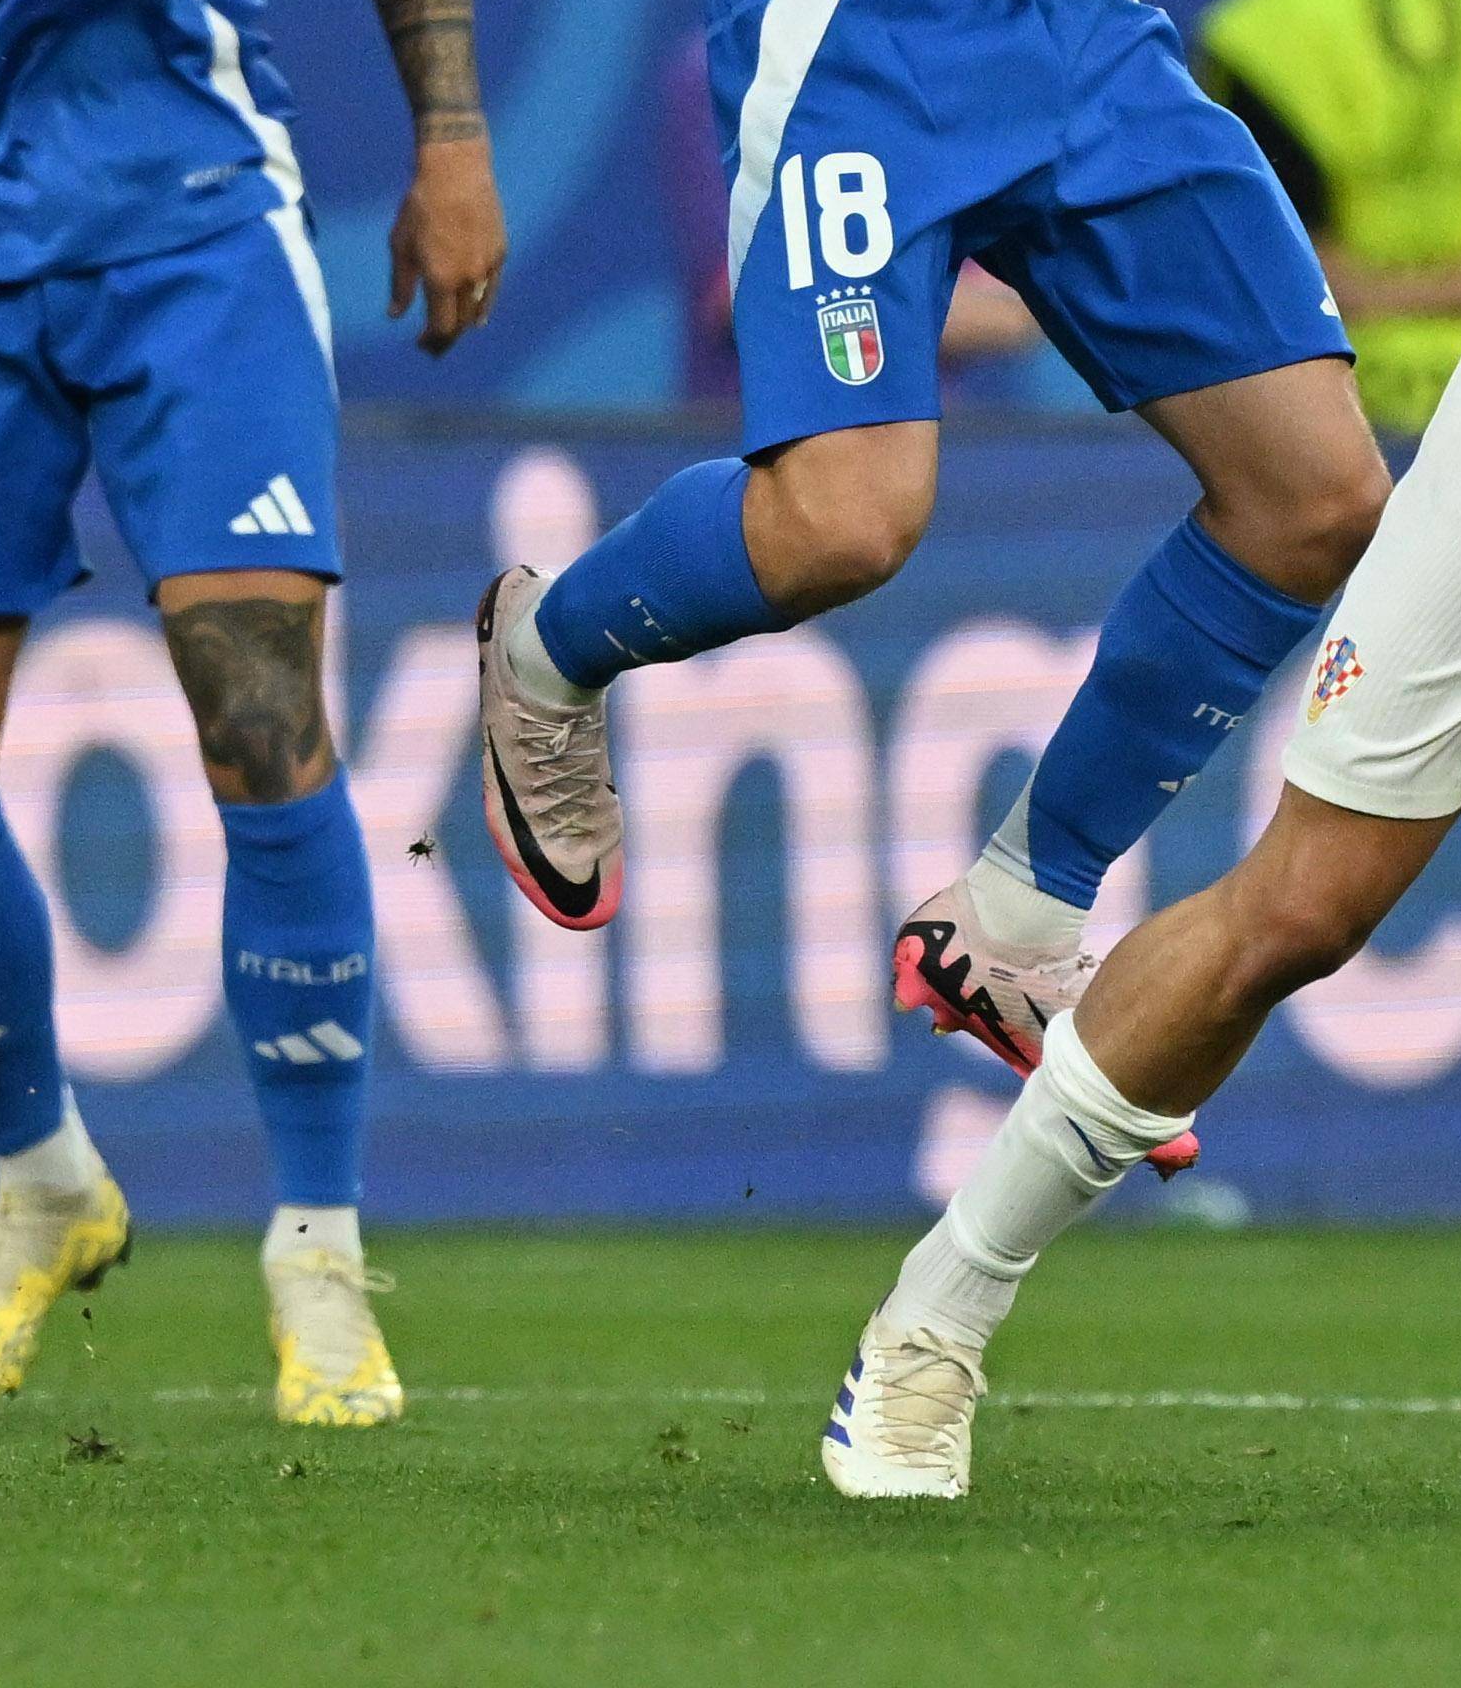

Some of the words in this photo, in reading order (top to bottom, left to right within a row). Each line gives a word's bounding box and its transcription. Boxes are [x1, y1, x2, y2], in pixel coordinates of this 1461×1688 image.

[780, 152, 894, 290] 18
[823, 305, 872, 329] ITALIA
[239, 951, 368, 985] ITALIA
